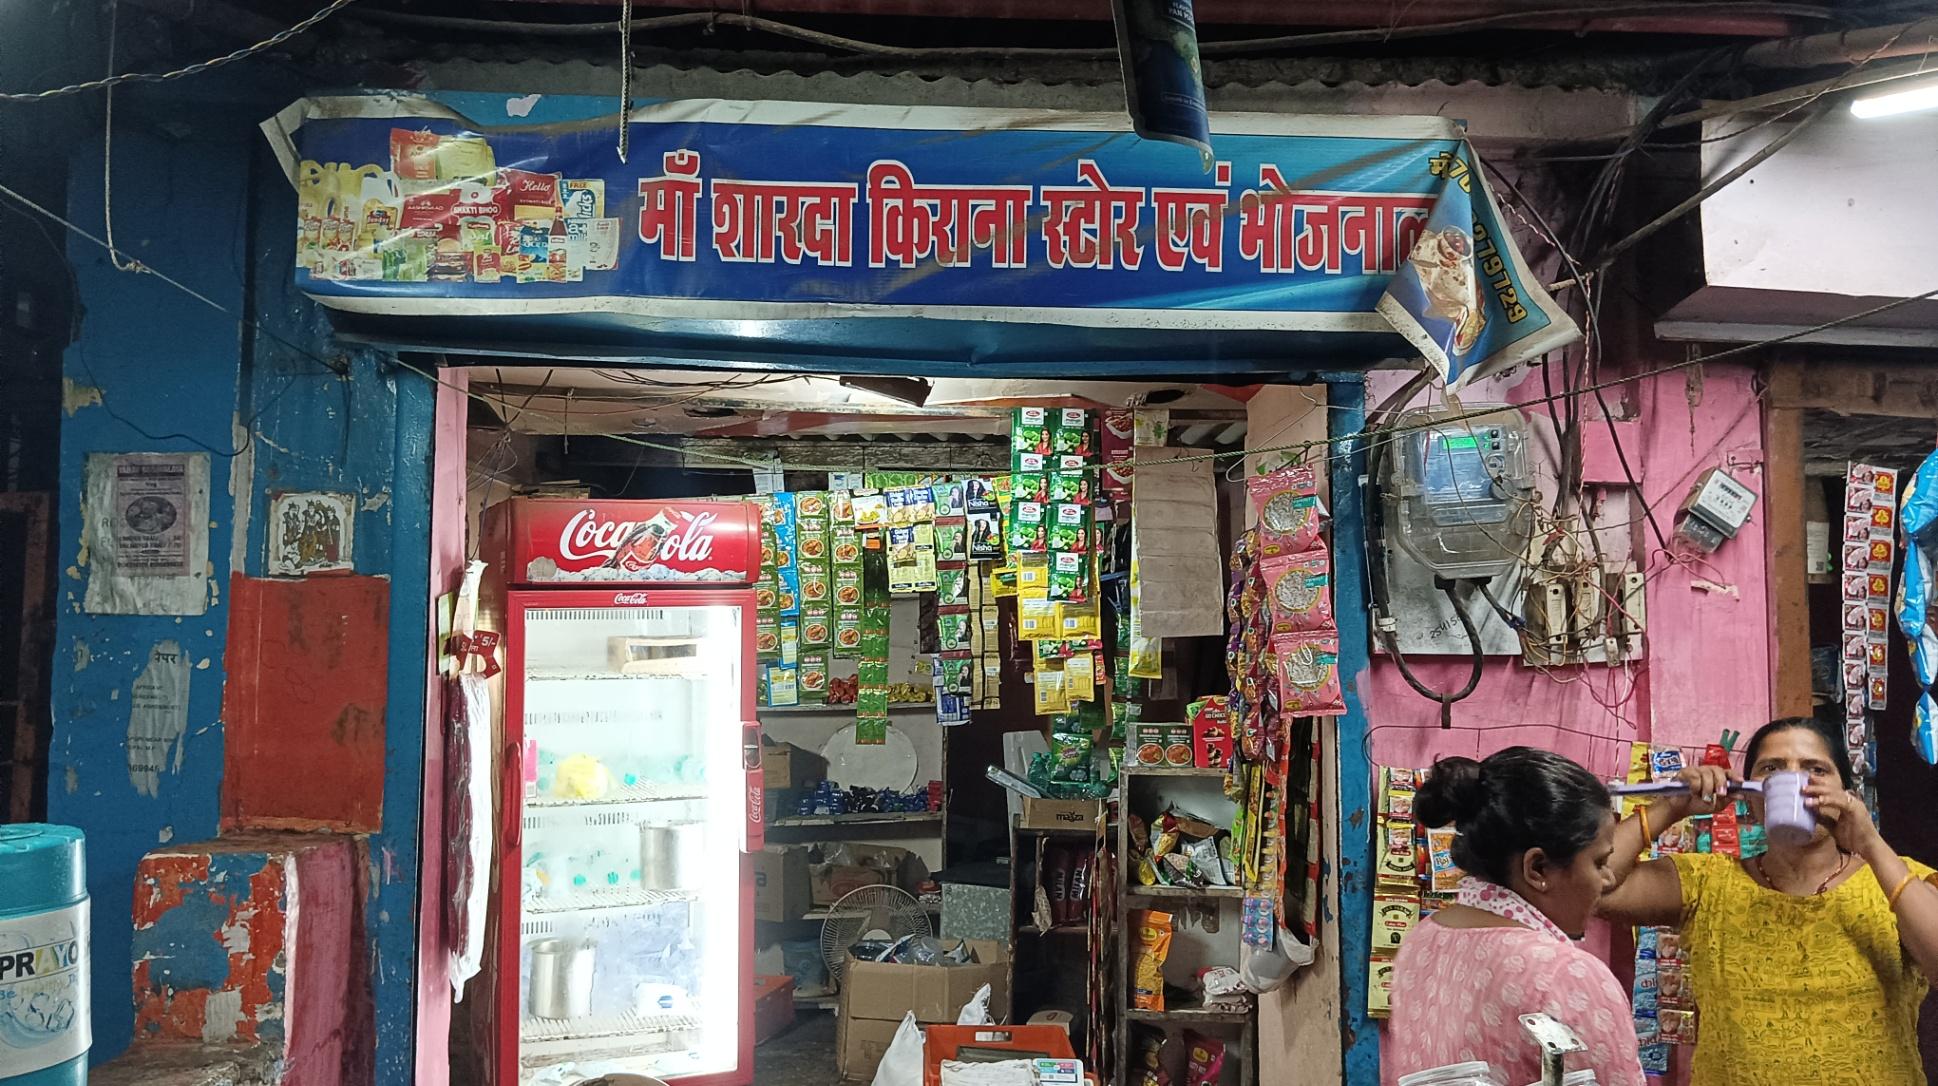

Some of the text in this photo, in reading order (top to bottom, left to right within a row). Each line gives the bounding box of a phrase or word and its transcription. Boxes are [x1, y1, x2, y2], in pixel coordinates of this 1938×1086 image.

[637, 148, 703, 262] माँ
[710, 177, 857, 268] शारदा
[867, 159, 1032, 270] किराना
[1040, 159, 1145, 271] स्टोर
[1152, 161, 1230, 273] एवं
